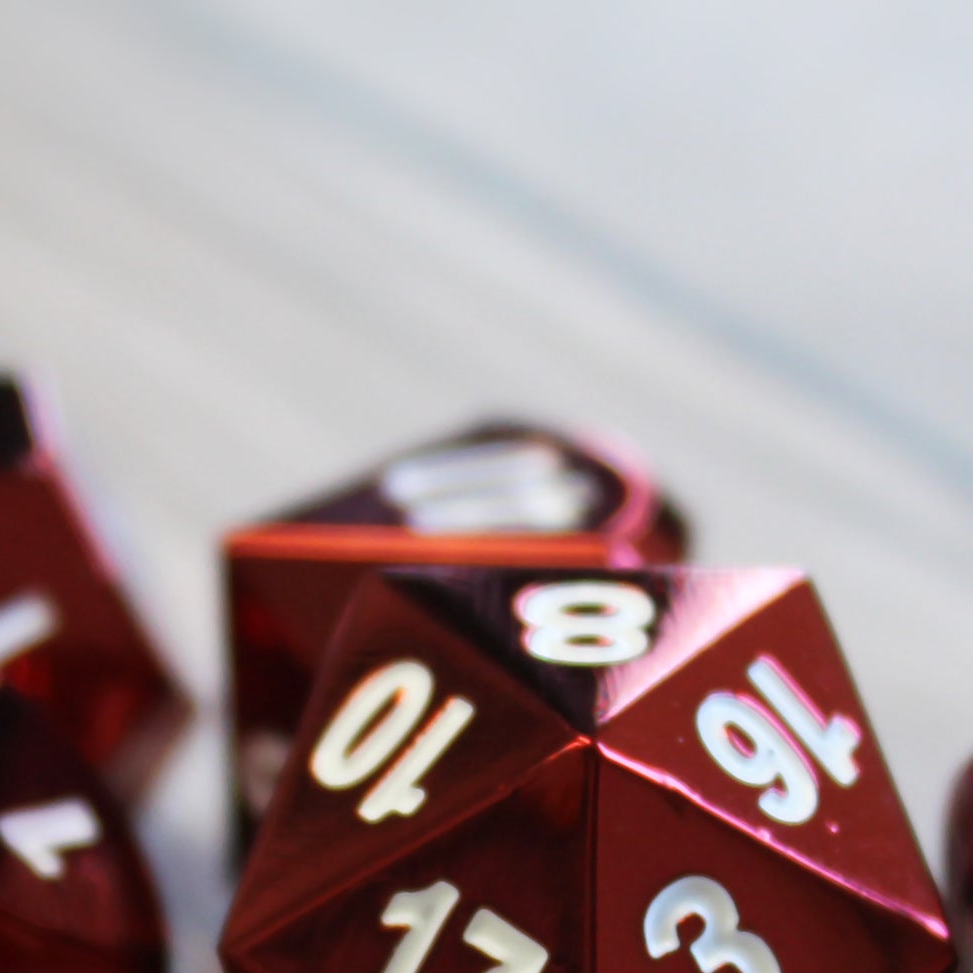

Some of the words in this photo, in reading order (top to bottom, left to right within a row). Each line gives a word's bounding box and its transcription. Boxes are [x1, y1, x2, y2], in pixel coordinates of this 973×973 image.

[515, 581, 657, 666] 8
[310, 660, 475, 824] 10
[695, 654, 860, 824] 16
